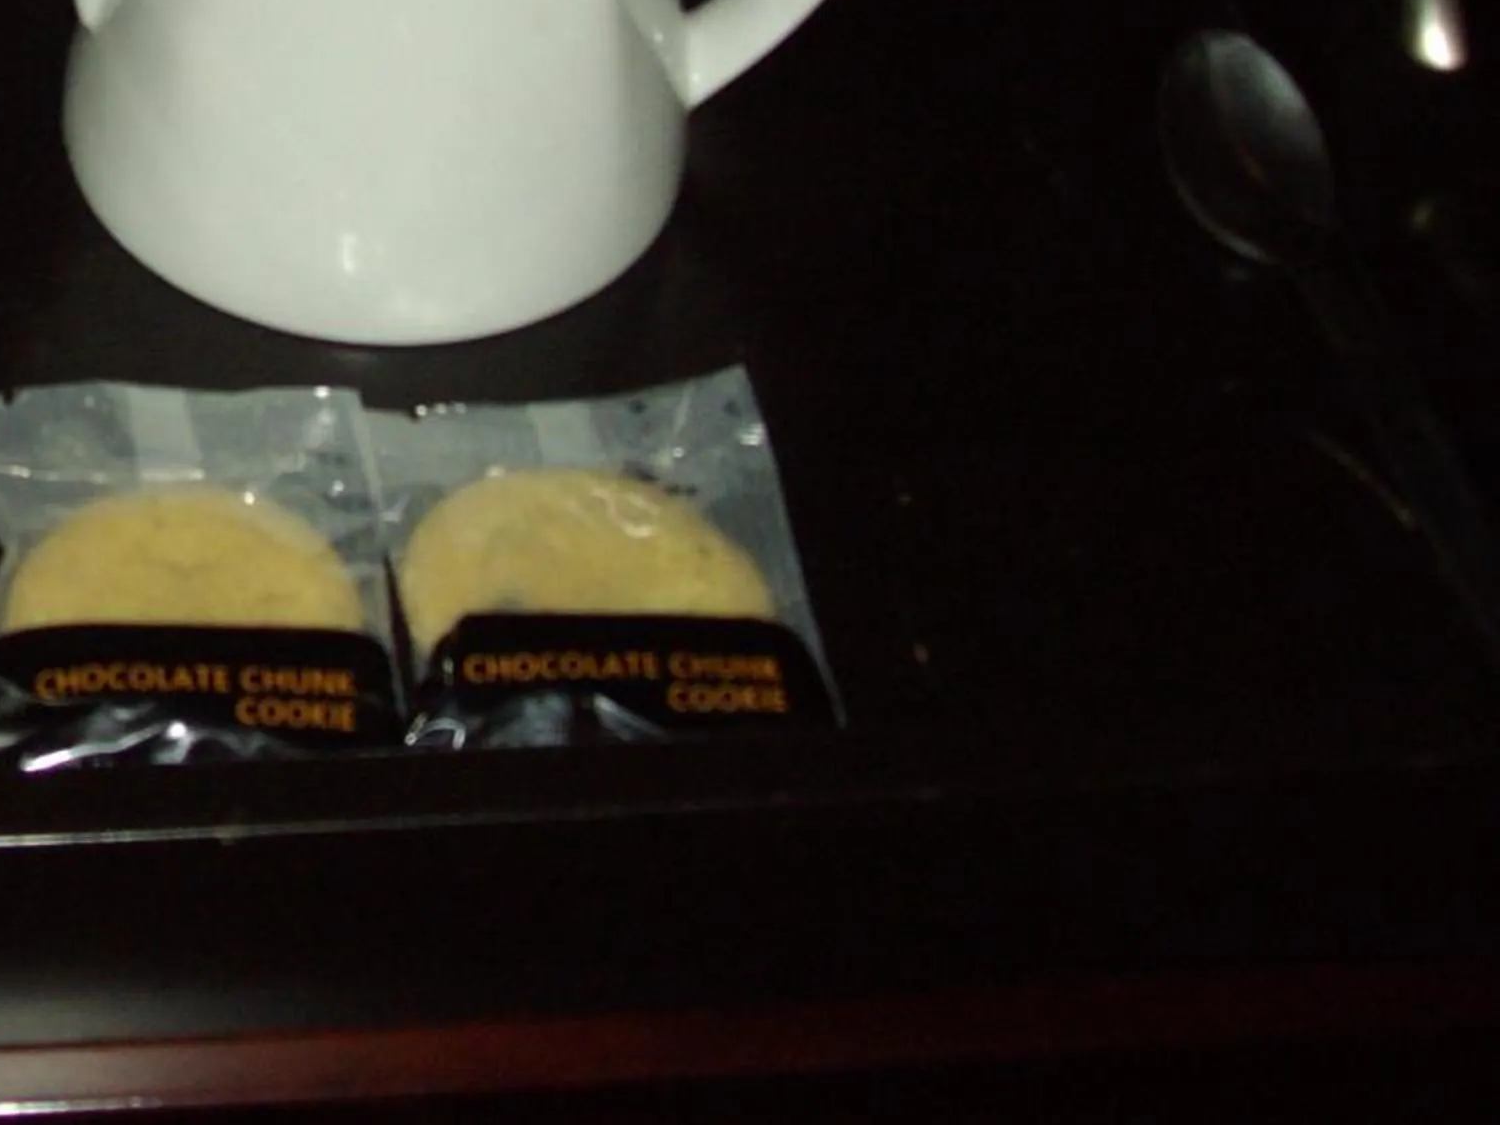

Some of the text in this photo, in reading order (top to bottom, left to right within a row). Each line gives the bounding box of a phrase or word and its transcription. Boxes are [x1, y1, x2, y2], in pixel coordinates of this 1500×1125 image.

[36, 661, 358, 700] CHOCOLATE CHUNK
[463, 650, 780, 683] CHOCOLATE CHUNK
[234, 695, 358, 732] COOKIE
[665, 681, 787, 714] COOKIE
